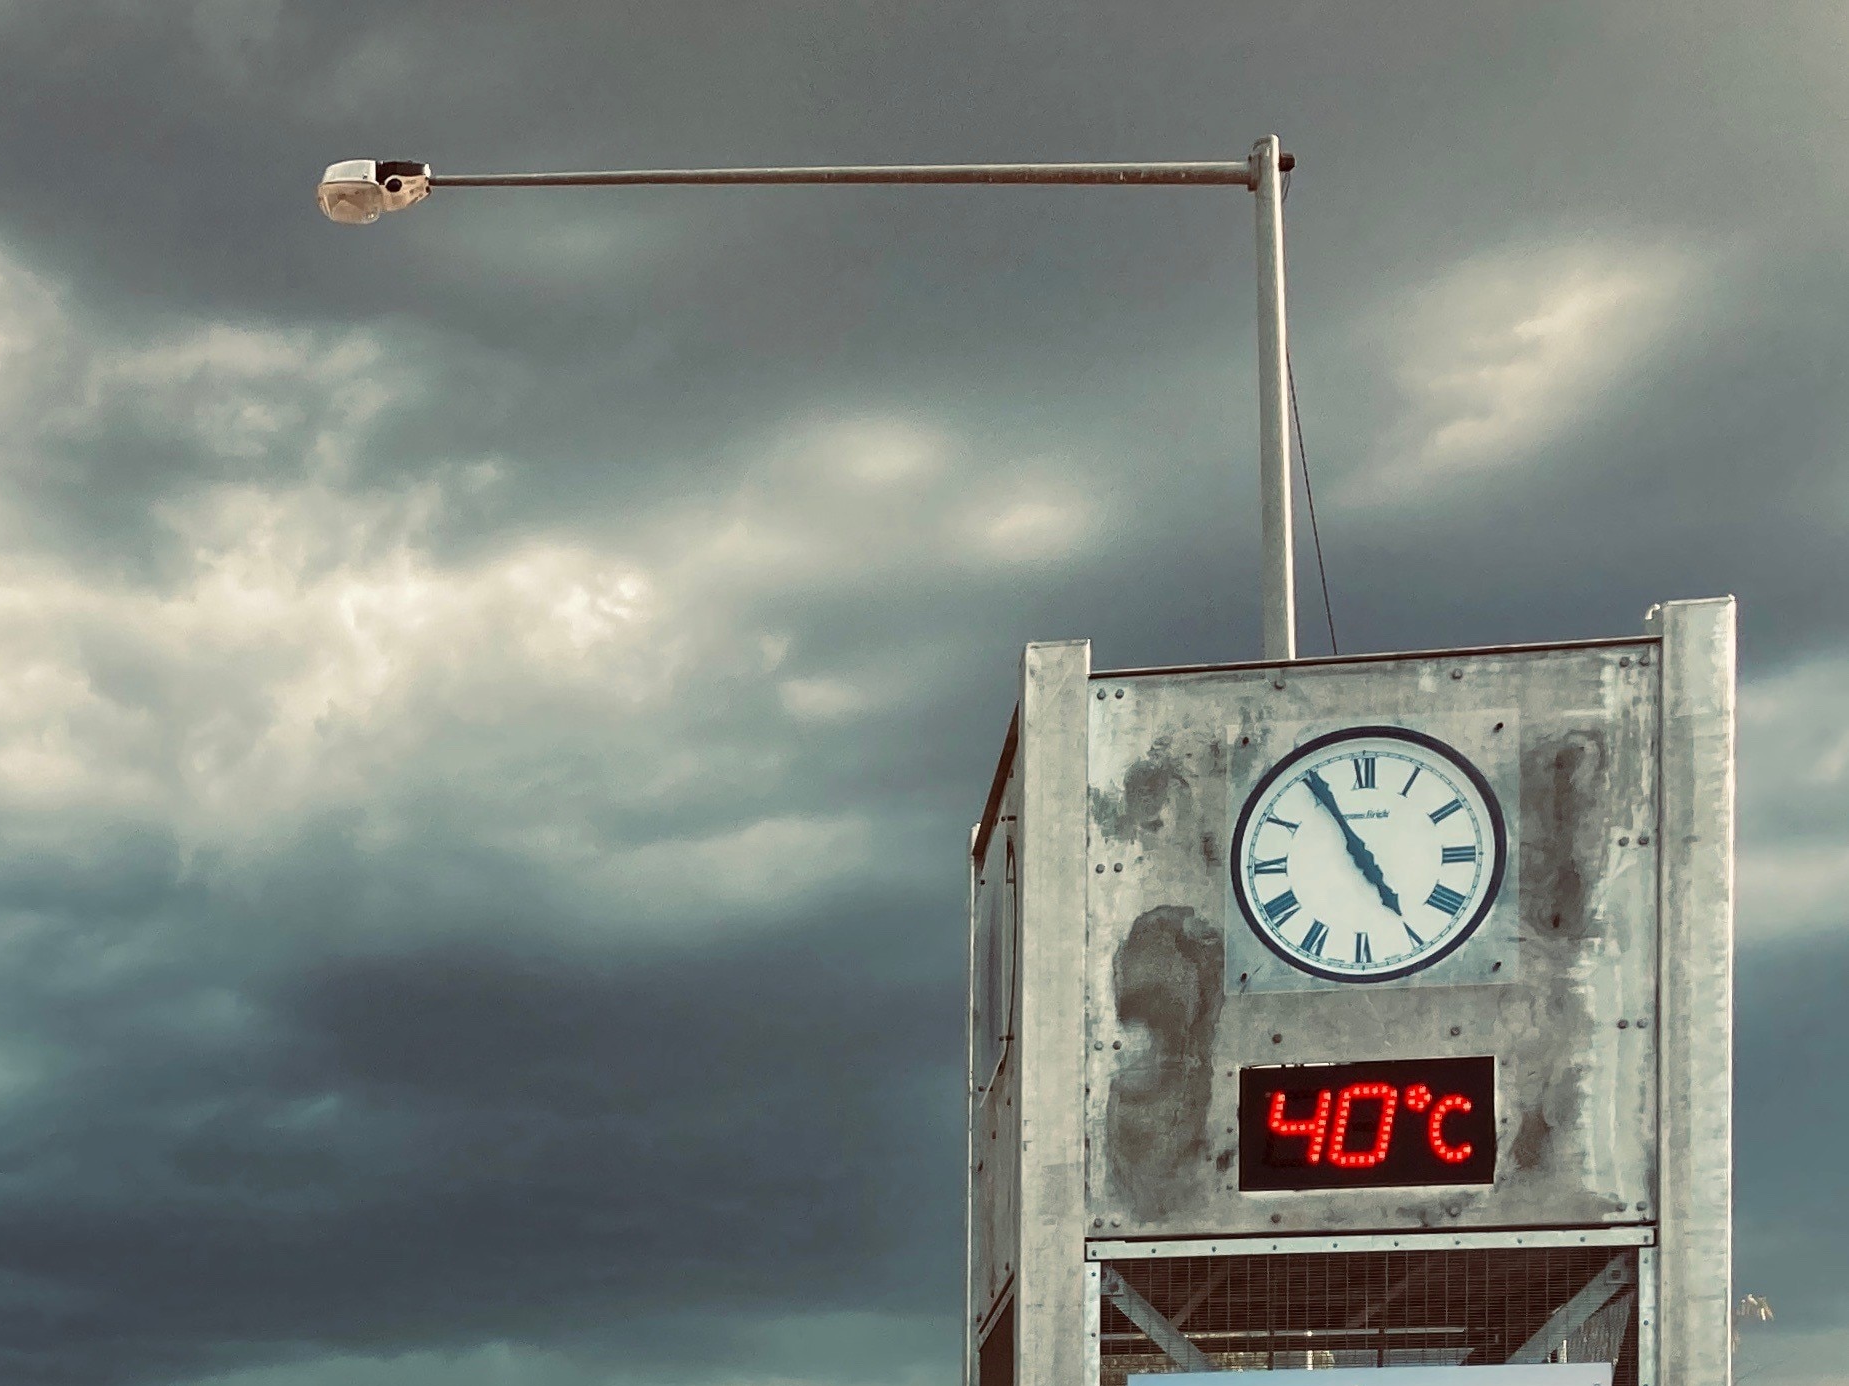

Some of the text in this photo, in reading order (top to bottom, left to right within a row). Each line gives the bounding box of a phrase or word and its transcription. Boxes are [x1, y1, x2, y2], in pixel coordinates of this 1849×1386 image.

[1352, 757, 1379, 790] XII
[1397, 766, 1423, 798] I
[1266, 809, 1302, 838] X
[1426, 798, 1467, 826] II
[1253, 854, 1289, 876] IX
[1441, 845, 1477, 865] III
[1262, 887, 1302, 929] VIII
[1300, 918, 1330, 957] VII
[1354, 931, 1375, 964] VI
[1402, 921, 1426, 950] V
